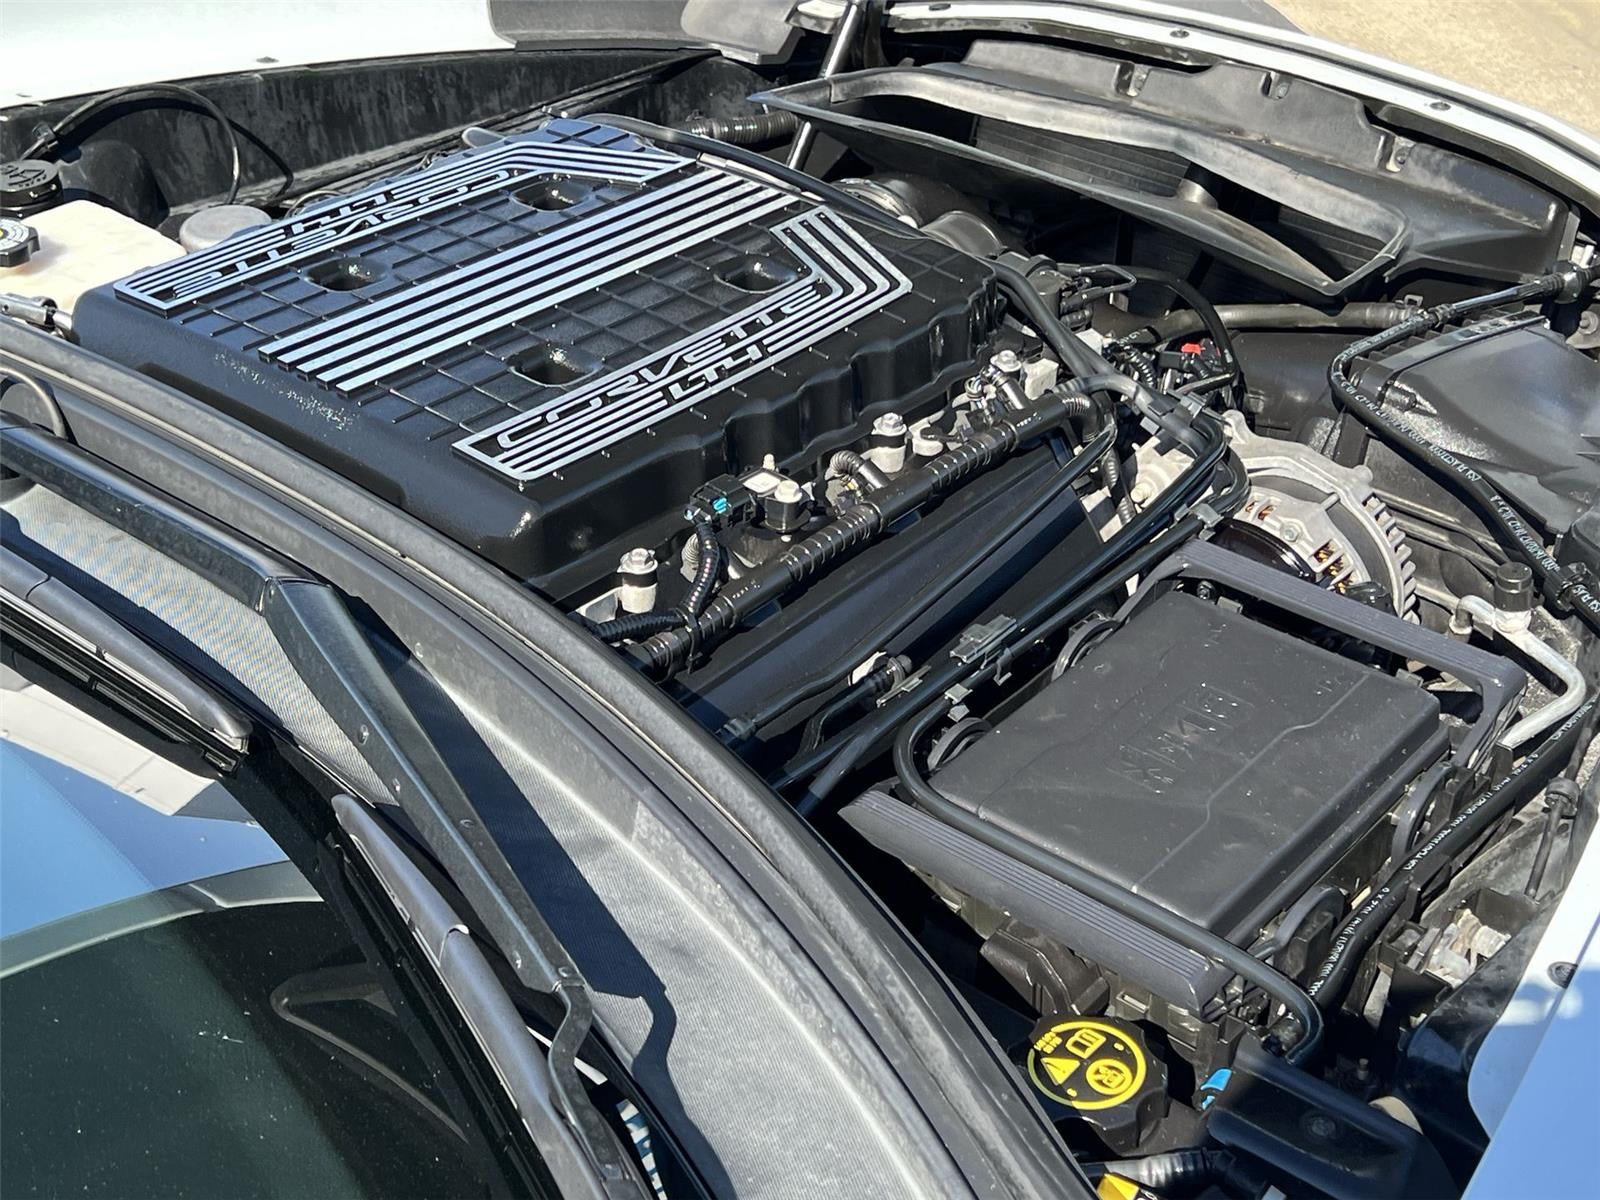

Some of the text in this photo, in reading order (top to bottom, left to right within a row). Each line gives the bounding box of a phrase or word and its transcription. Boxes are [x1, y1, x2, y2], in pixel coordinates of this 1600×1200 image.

[172, 169, 510, 300] CORVETTE
[497, 285, 822, 449] CORVETTE
[668, 344, 763, 400] LT4
